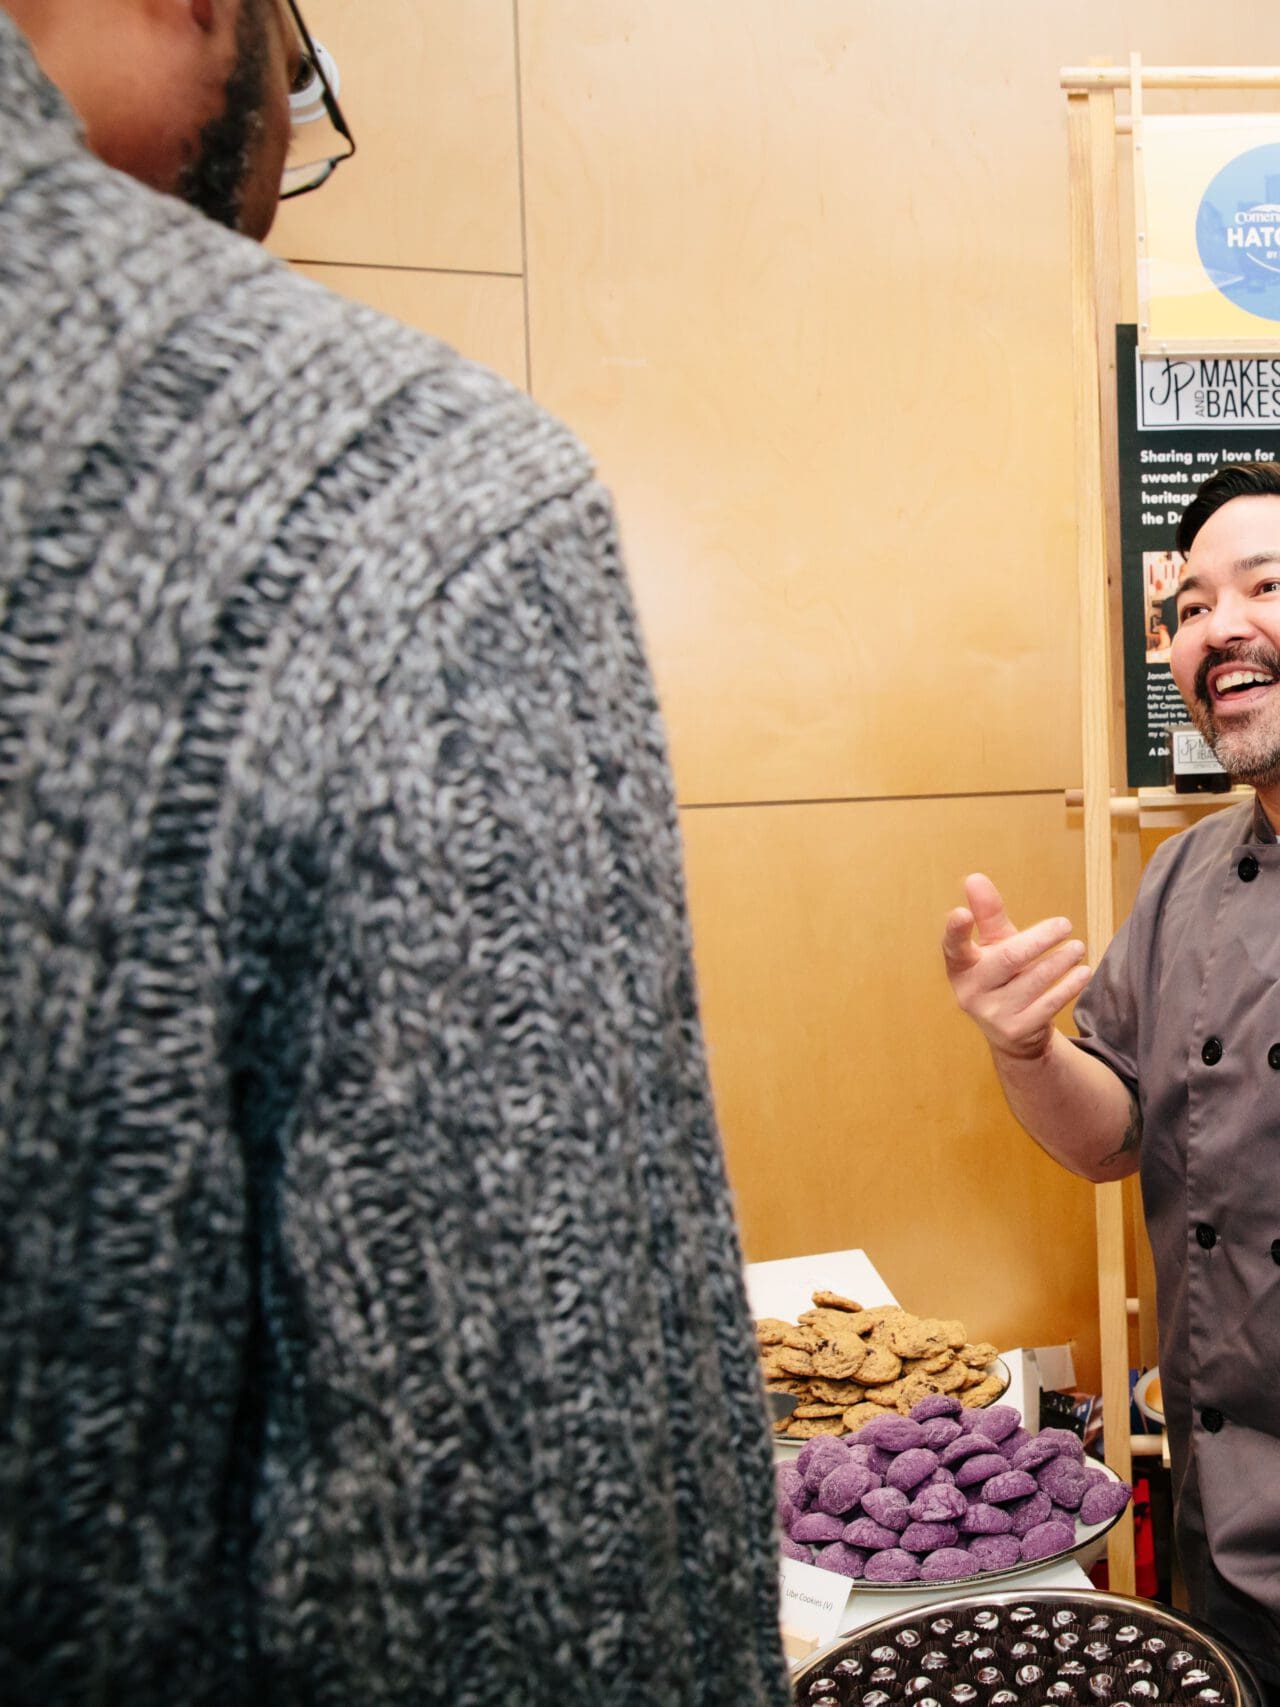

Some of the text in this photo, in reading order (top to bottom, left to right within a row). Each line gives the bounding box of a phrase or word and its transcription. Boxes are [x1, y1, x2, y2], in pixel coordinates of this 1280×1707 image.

[1266, 251, 1277, 259] BY
[1140, 448, 1275, 465] Sharing my love for
[1141, 471, 1189, 483] sweets
[1141, 511, 1165, 525] the
[786, 1589, 799, 1599] Ube
[799, 1593, 823, 1607] Cookies
